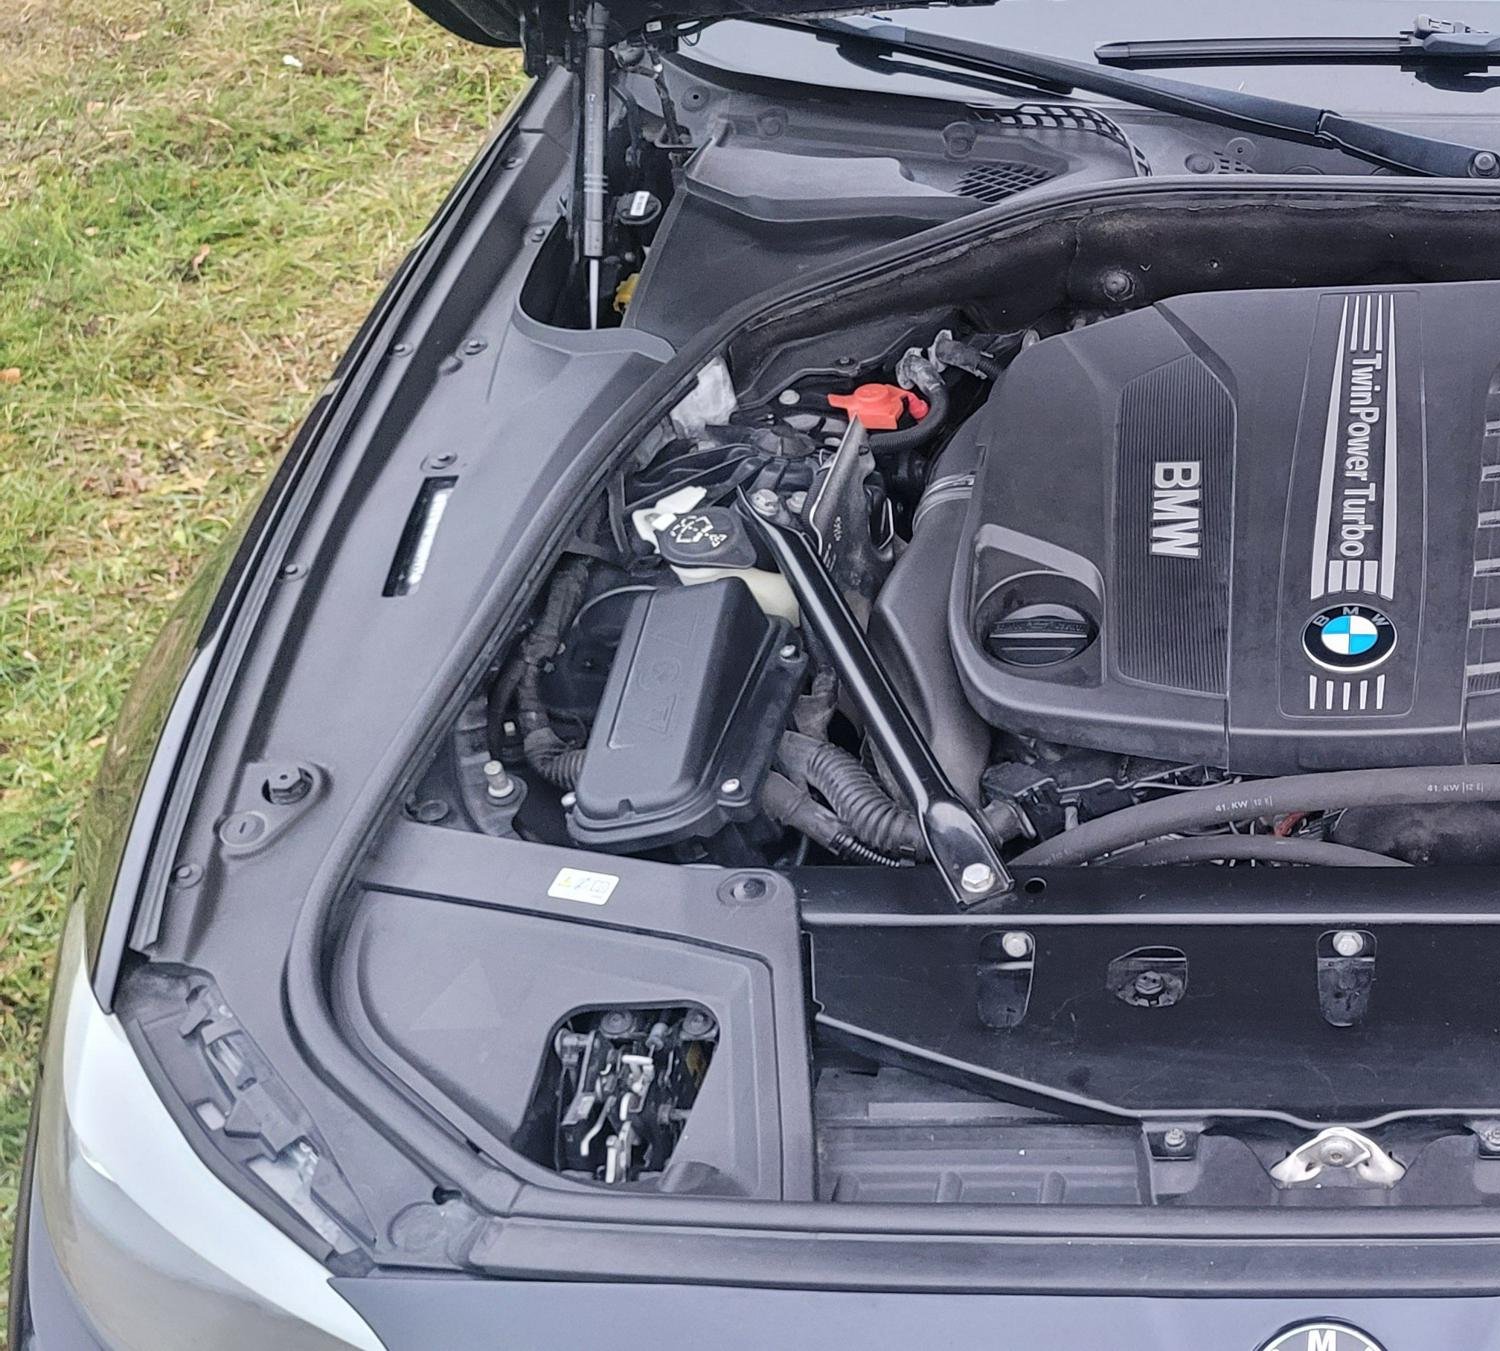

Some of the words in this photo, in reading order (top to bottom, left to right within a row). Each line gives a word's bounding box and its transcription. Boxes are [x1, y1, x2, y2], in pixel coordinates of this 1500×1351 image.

[1345, 352, 1382, 481] TwinPower
[1151, 461, 1200, 557] BMW
[1340, 483, 1376, 557] Turbo
[1312, 606, 1390, 627] BMW
